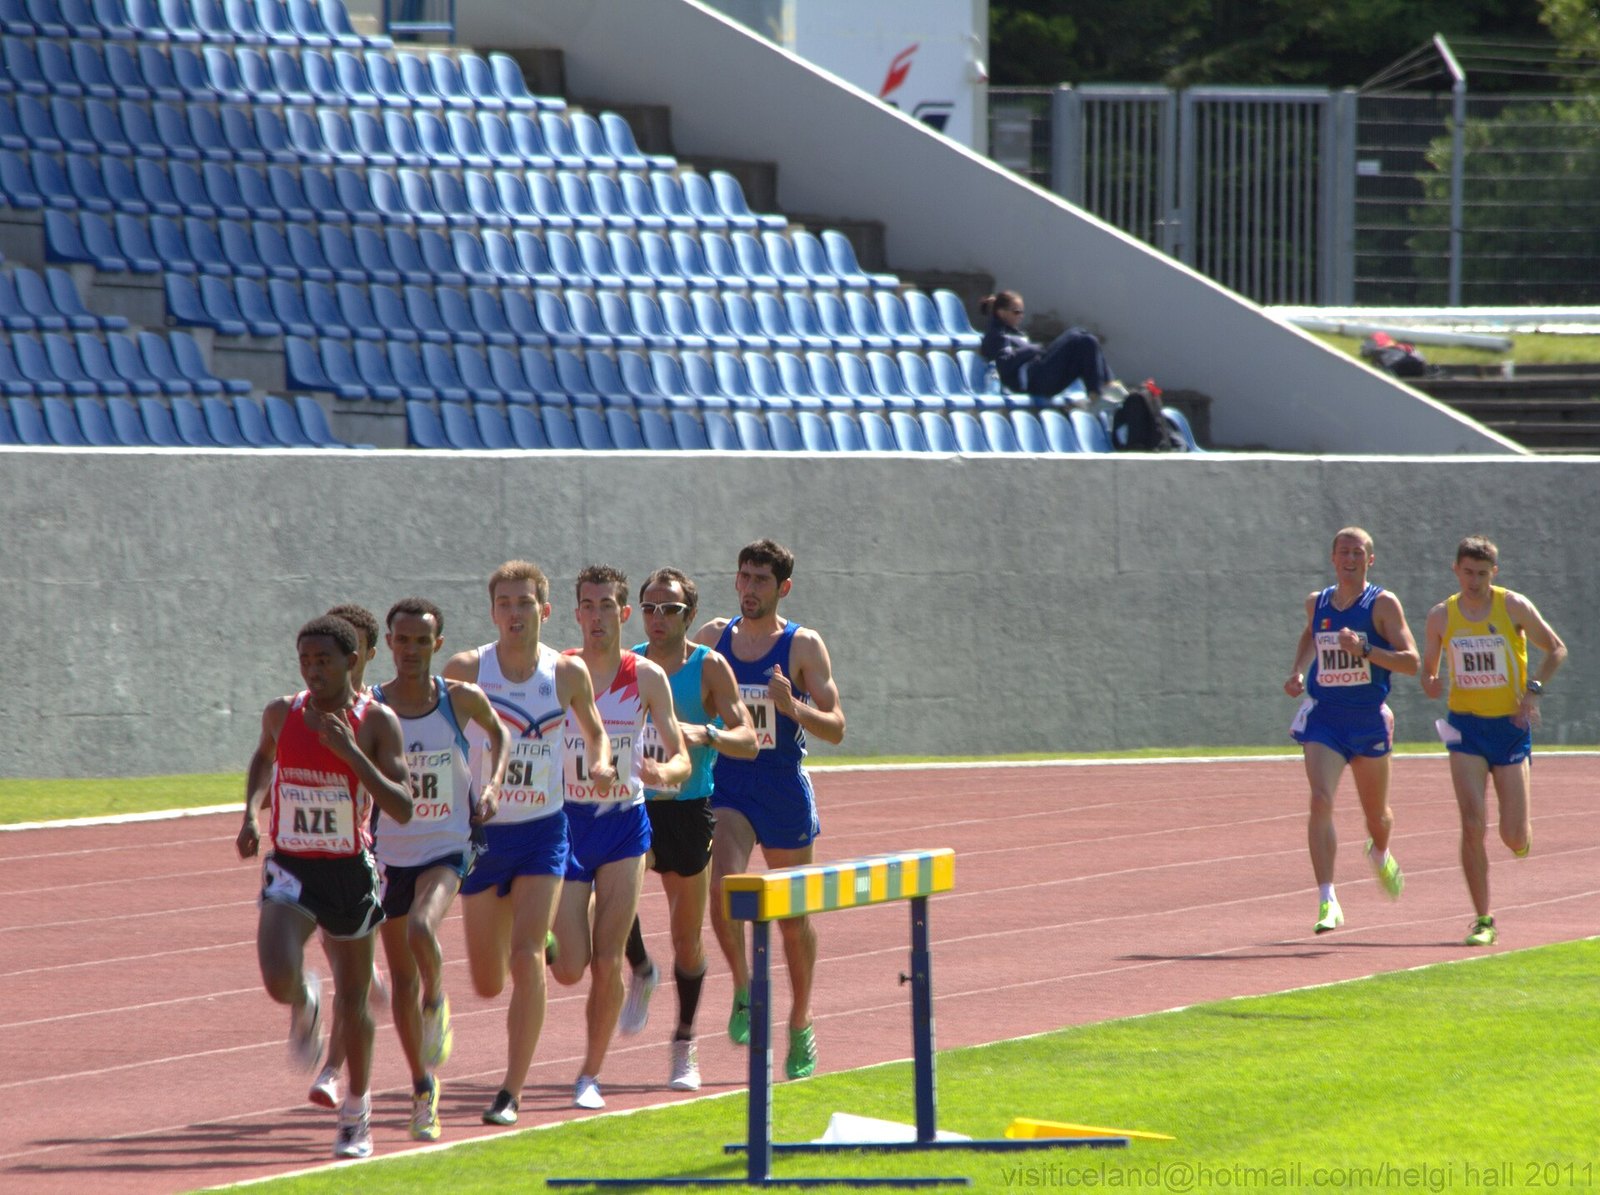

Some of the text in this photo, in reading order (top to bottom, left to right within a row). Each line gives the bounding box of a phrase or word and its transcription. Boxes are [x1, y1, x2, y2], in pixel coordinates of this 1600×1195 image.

[1322, 649, 1364, 670] MDA
[1320, 672, 1369, 684] TOYOTA
[1456, 674, 1506, 685] TOYOTA
[502, 760, 533, 786] SL
[576, 755, 619, 780] LX
[281, 787, 350, 802] VALITOR
[410, 772, 438, 799] SR
[294, 807, 337, 834] AZE
[281, 838, 350, 848] TOYOTA
